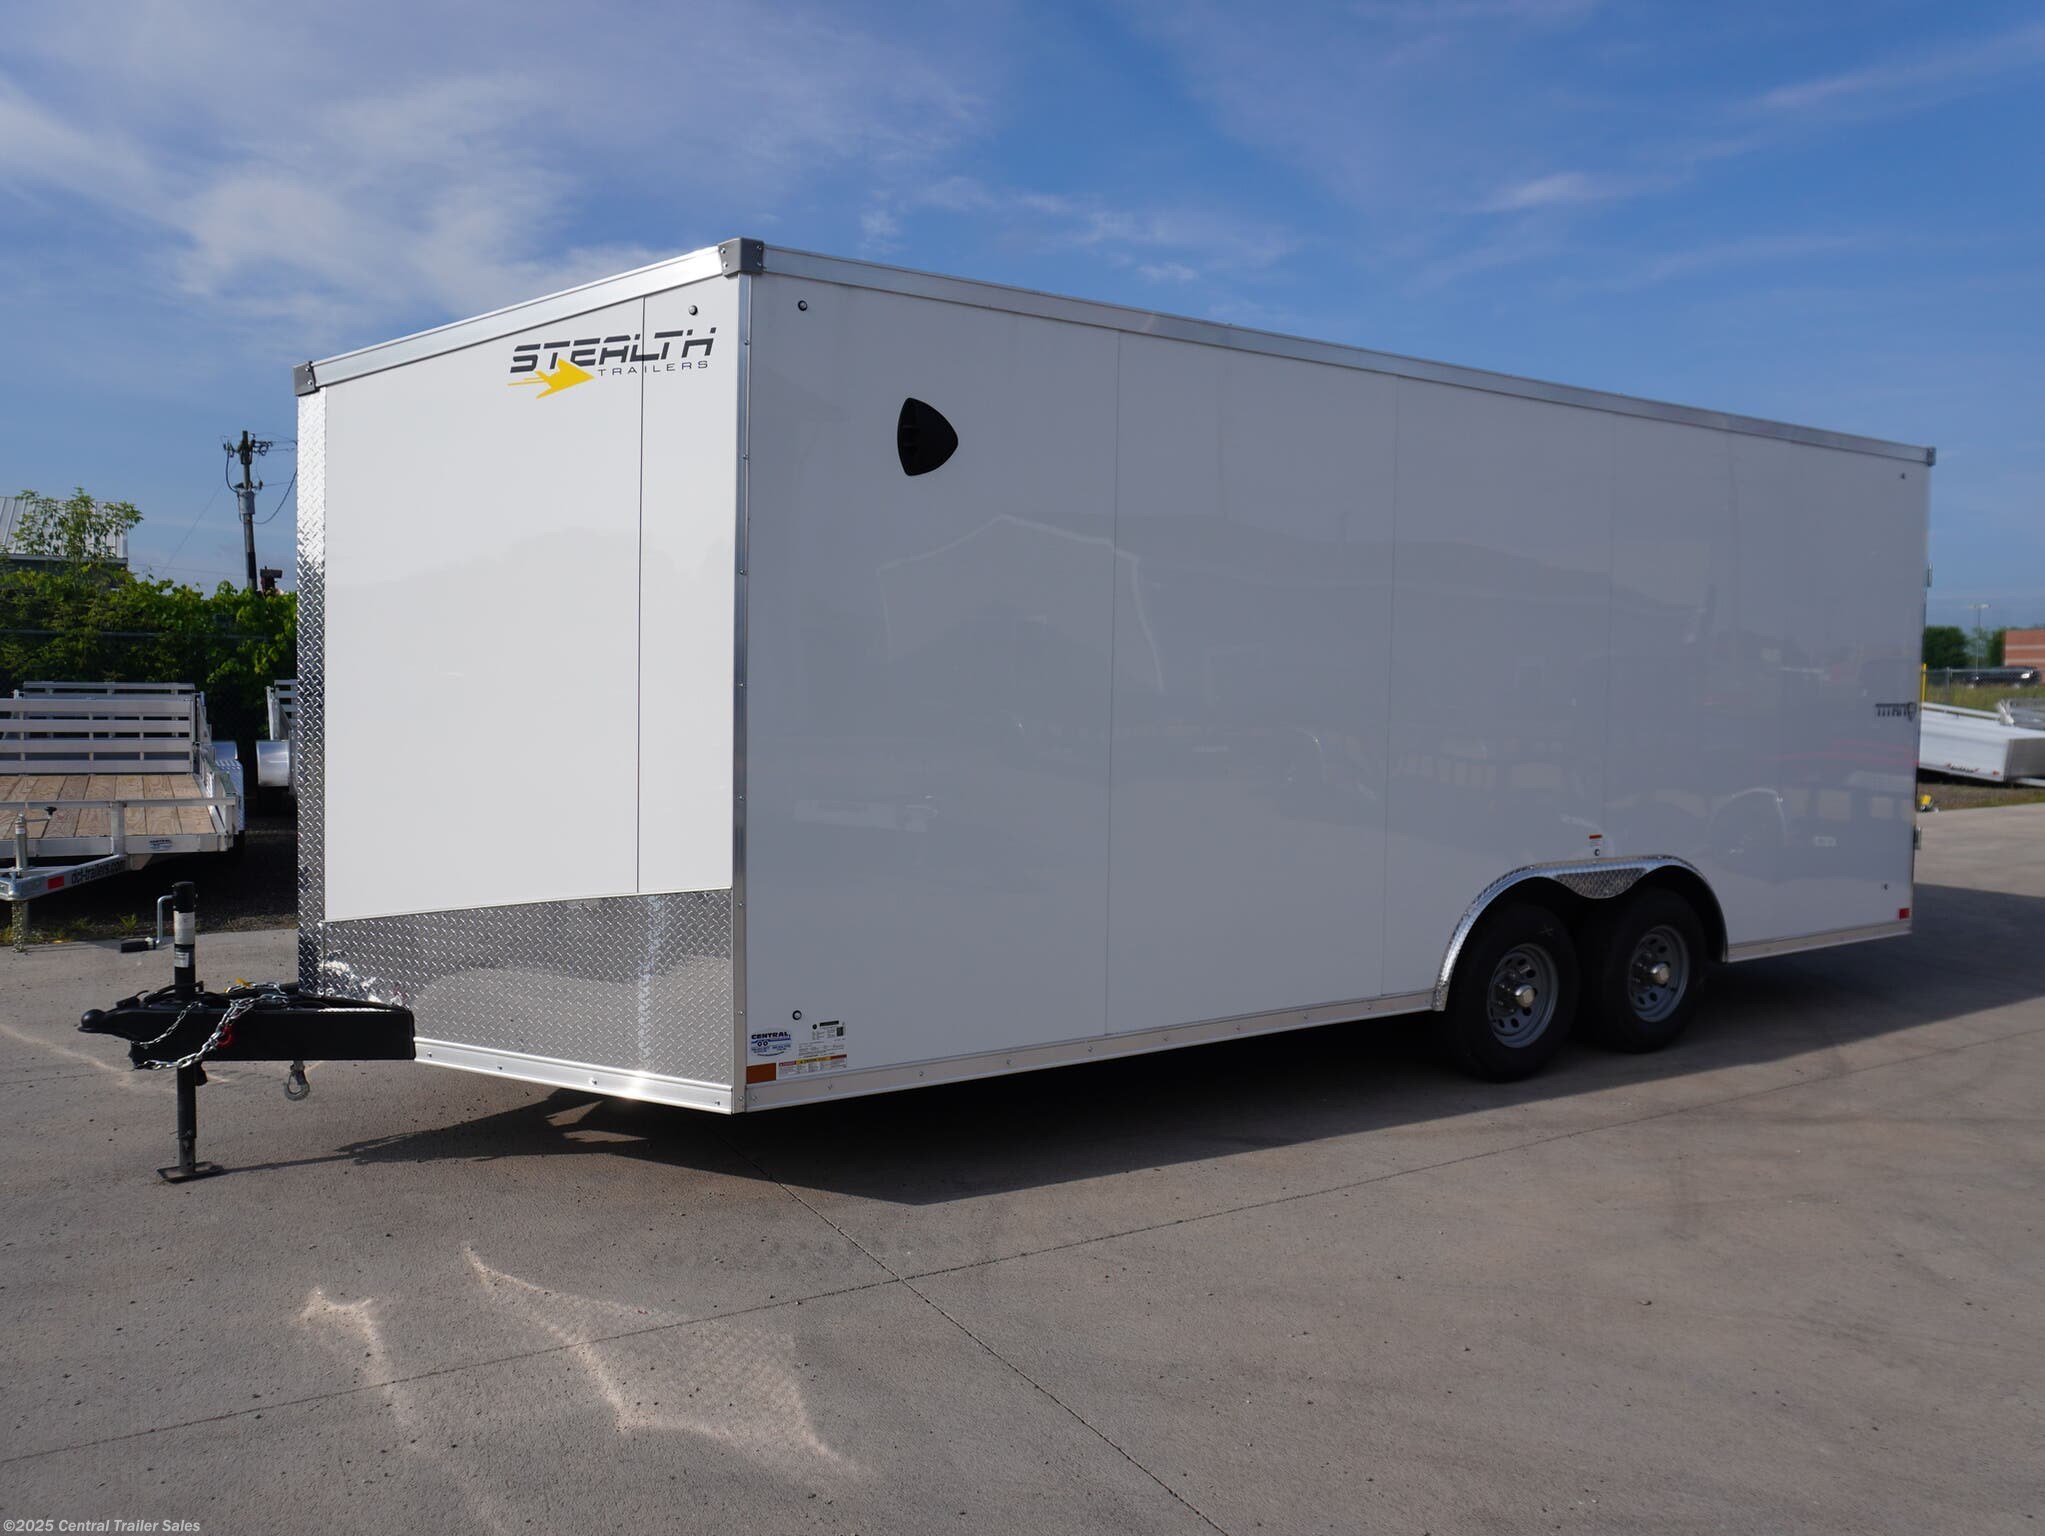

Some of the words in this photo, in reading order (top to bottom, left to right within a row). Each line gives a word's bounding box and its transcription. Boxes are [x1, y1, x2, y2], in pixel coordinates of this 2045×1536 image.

[510, 327, 717, 373] STEALTH
[598, 360, 708, 376] TRAILERS
[751, 1031, 788, 1039] CENTRAL
